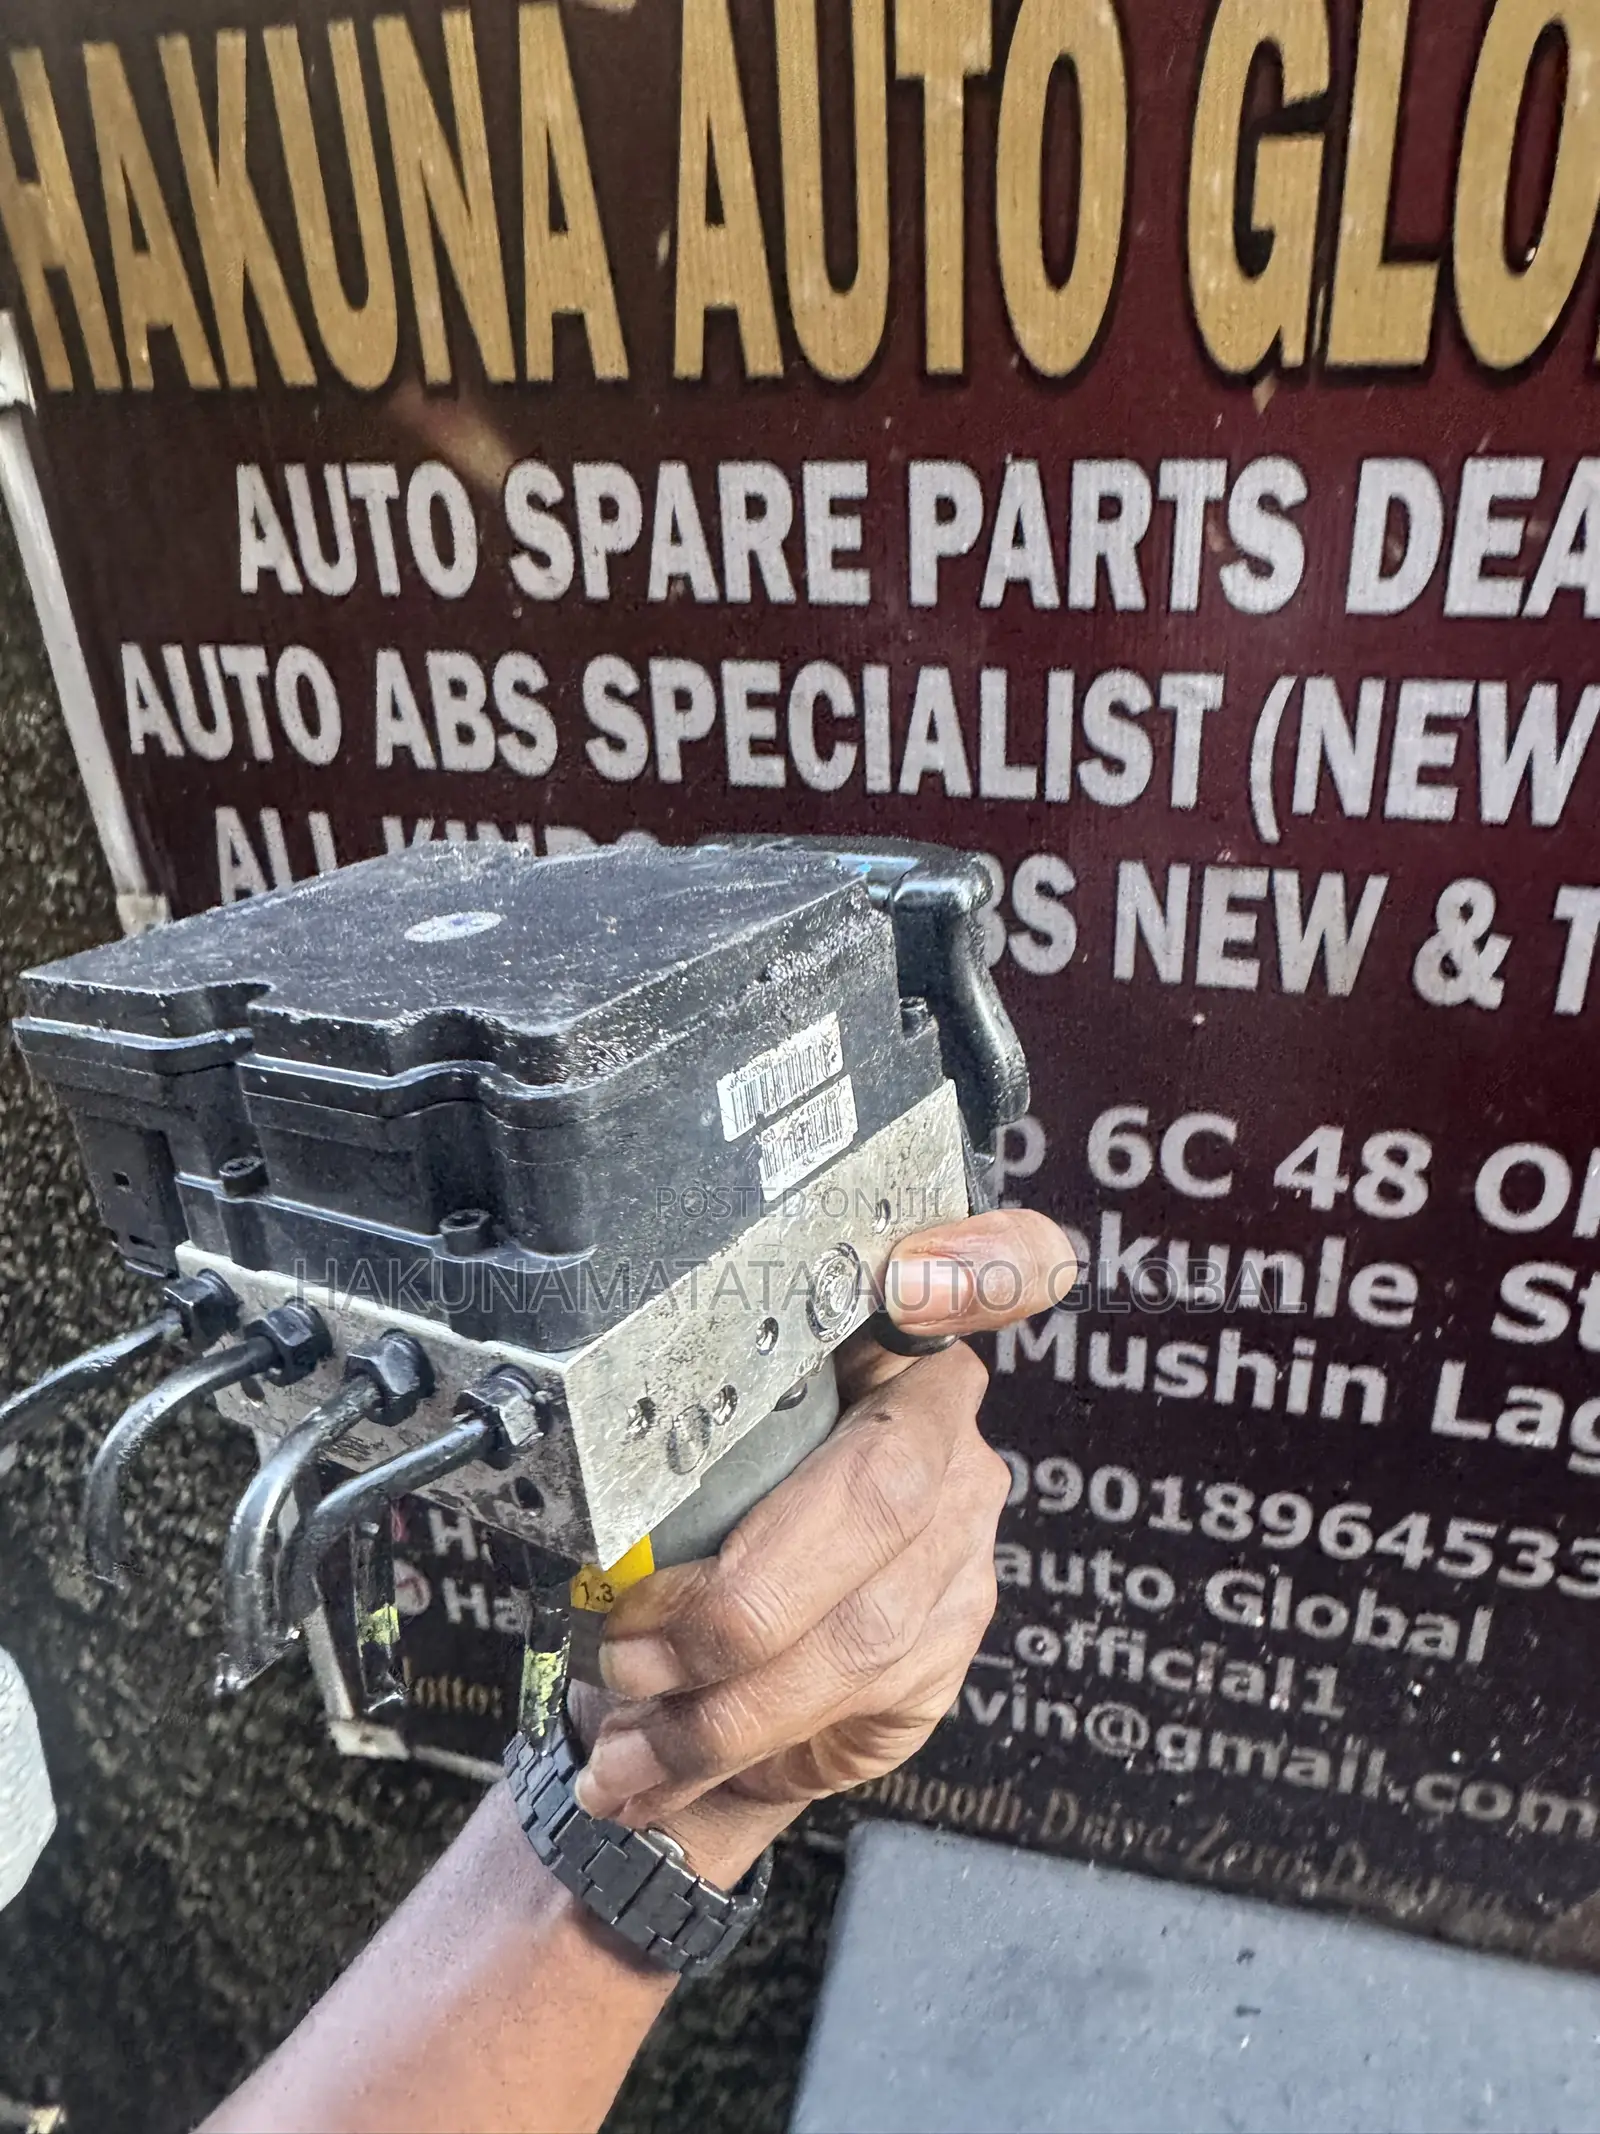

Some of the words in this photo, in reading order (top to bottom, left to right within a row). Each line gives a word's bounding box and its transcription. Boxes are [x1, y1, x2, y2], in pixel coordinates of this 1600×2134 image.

[0, 3, 629, 392] HAKUNA
[673, 0, 1127, 382] AUTO
[1188, 0, 1600, 374] GLO
[236, 462, 479, 598] AUTO
[503, 458, 871, 606] SPARE
[907, 456, 1307, 614] PARTS
[1344, 456, 1600, 619] DEA
[120, 641, 341, 767] AUTO
[375, 649, 558, 778] ABS
[582, 654, 1224, 811] SPECIALIST
[1249, 676, 1600, 845] (NEW
[1112, 860, 1389, 997] NEW
[1412, 877, 1513, 1011] &
[1086, 1104, 1238, 1199] 6C
[1273, 1123, 1433, 1221] 48
[995, 1313, 1390, 1427] Mushin
[1204, 1568, 1494, 1666] Global
[950, 1683, 1600, 1842] vin@gmail.com
